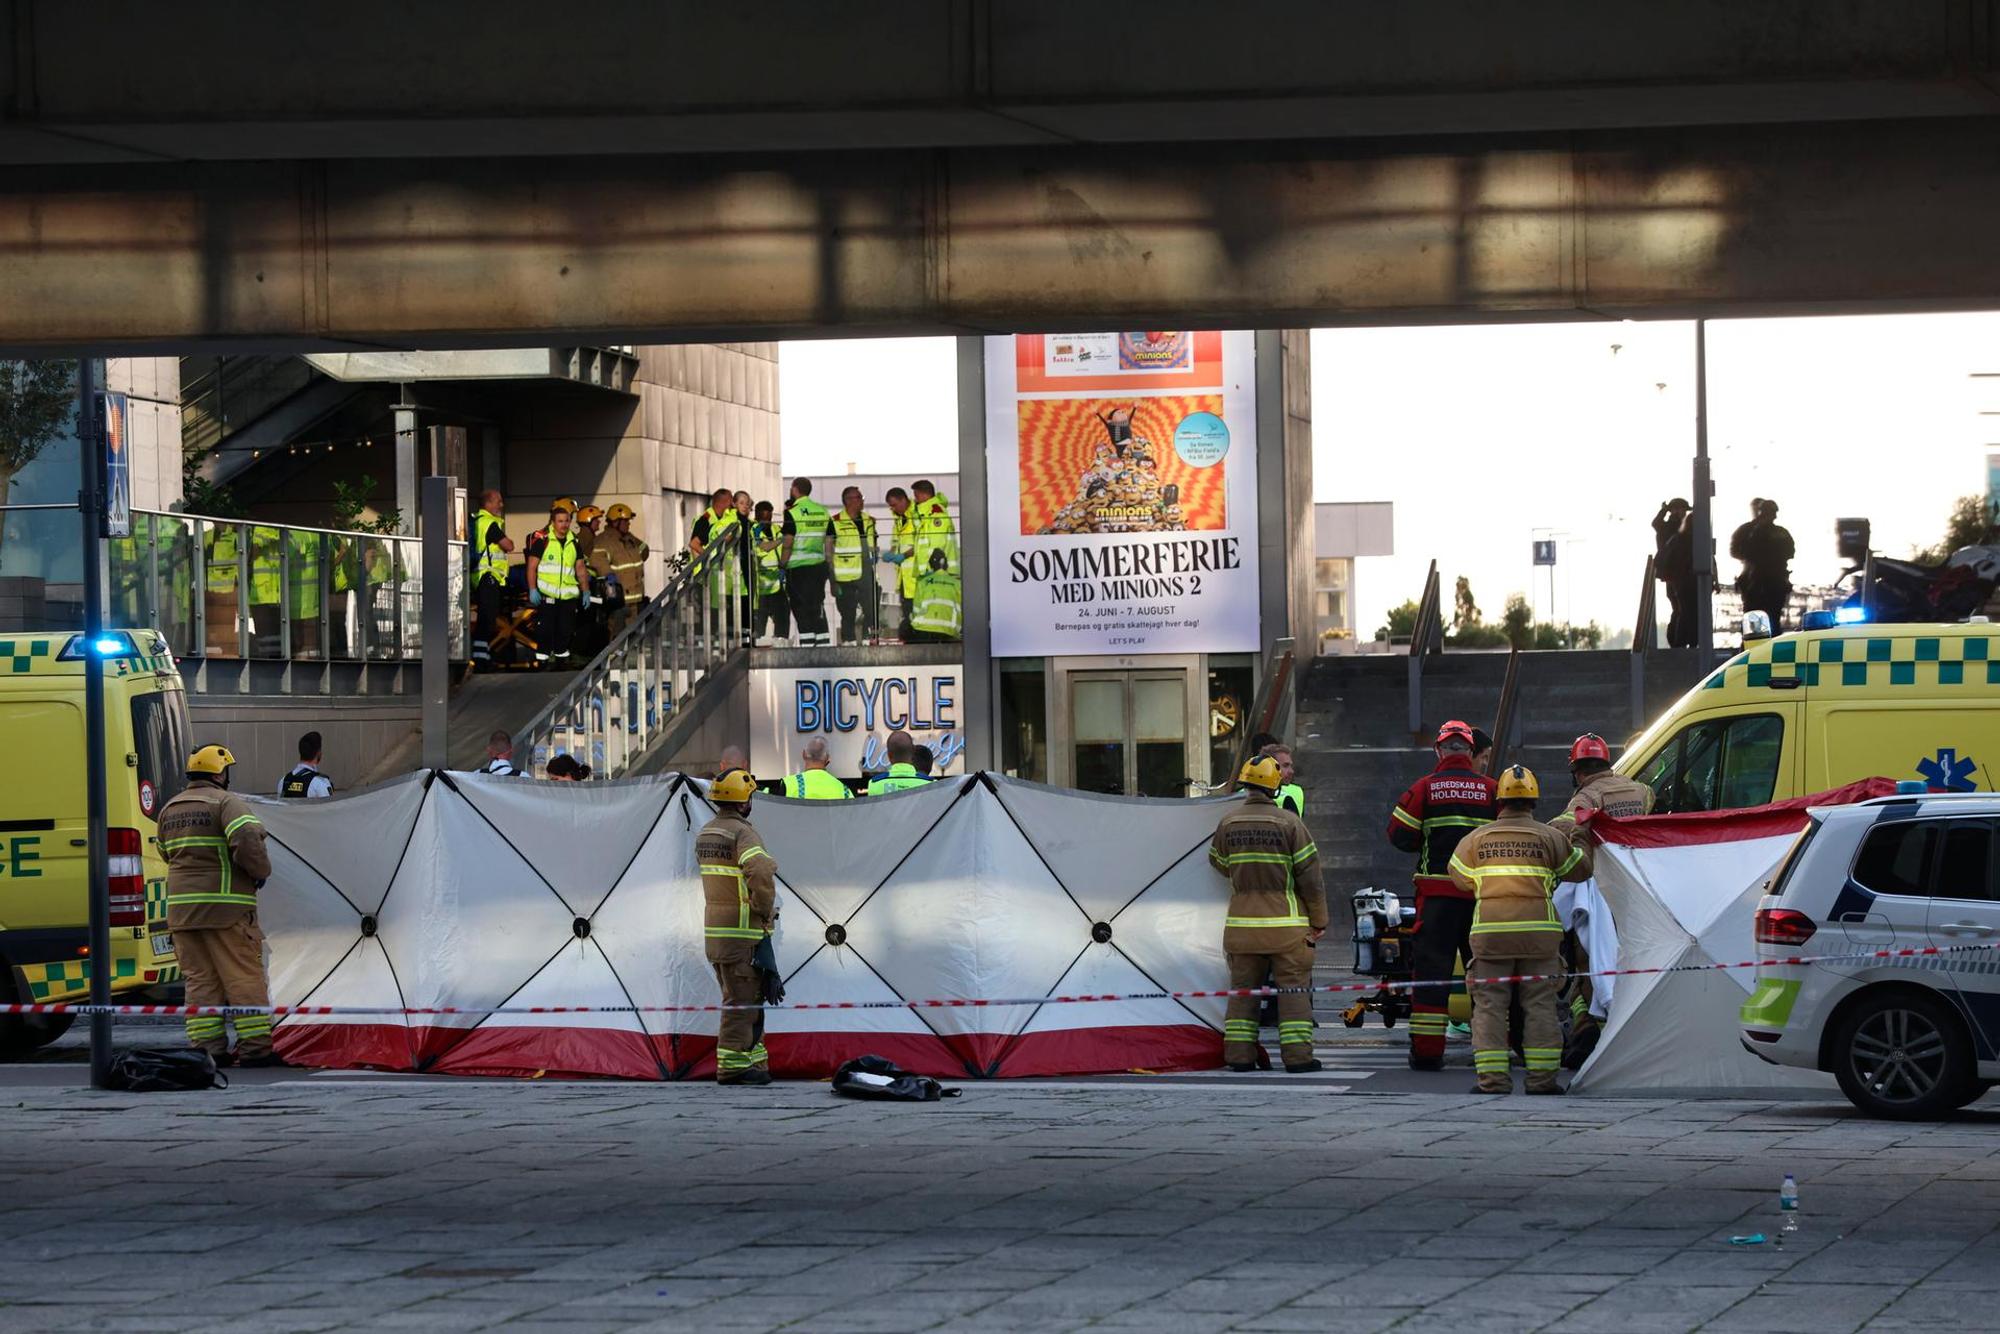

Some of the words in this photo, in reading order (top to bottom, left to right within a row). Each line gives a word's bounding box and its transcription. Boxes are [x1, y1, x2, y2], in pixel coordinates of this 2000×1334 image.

[1096, 506, 1152, 516] minions
[1010, 537, 1241, 583] SOMMERFERIE
[1051, 583, 1095, 604] MED
[1101, 576, 1184, 601] MINIONS
[1190, 575, 1202, 595] 2
[1095, 607, 1118, 617] JUNI
[1137, 605, 1176, 616] AUGUST
[1055, 622, 1091, 631] Børnepas
[1092, 623, 1102, 631] og
[1103, 621, 1125, 631] gratis
[1127, 620, 1164, 630] skattejagt
[1165, 620, 1182, 628] hver
[1128, 637, 1146, 645] PLAY
[796, 676, 955, 732] BICYCLE
[1430, 780, 1476, 791] BEREDSKAB
[1430, 790, 1487, 800] HOLDLEDER
[1478, 849, 1544, 860] BEREDSKAB
